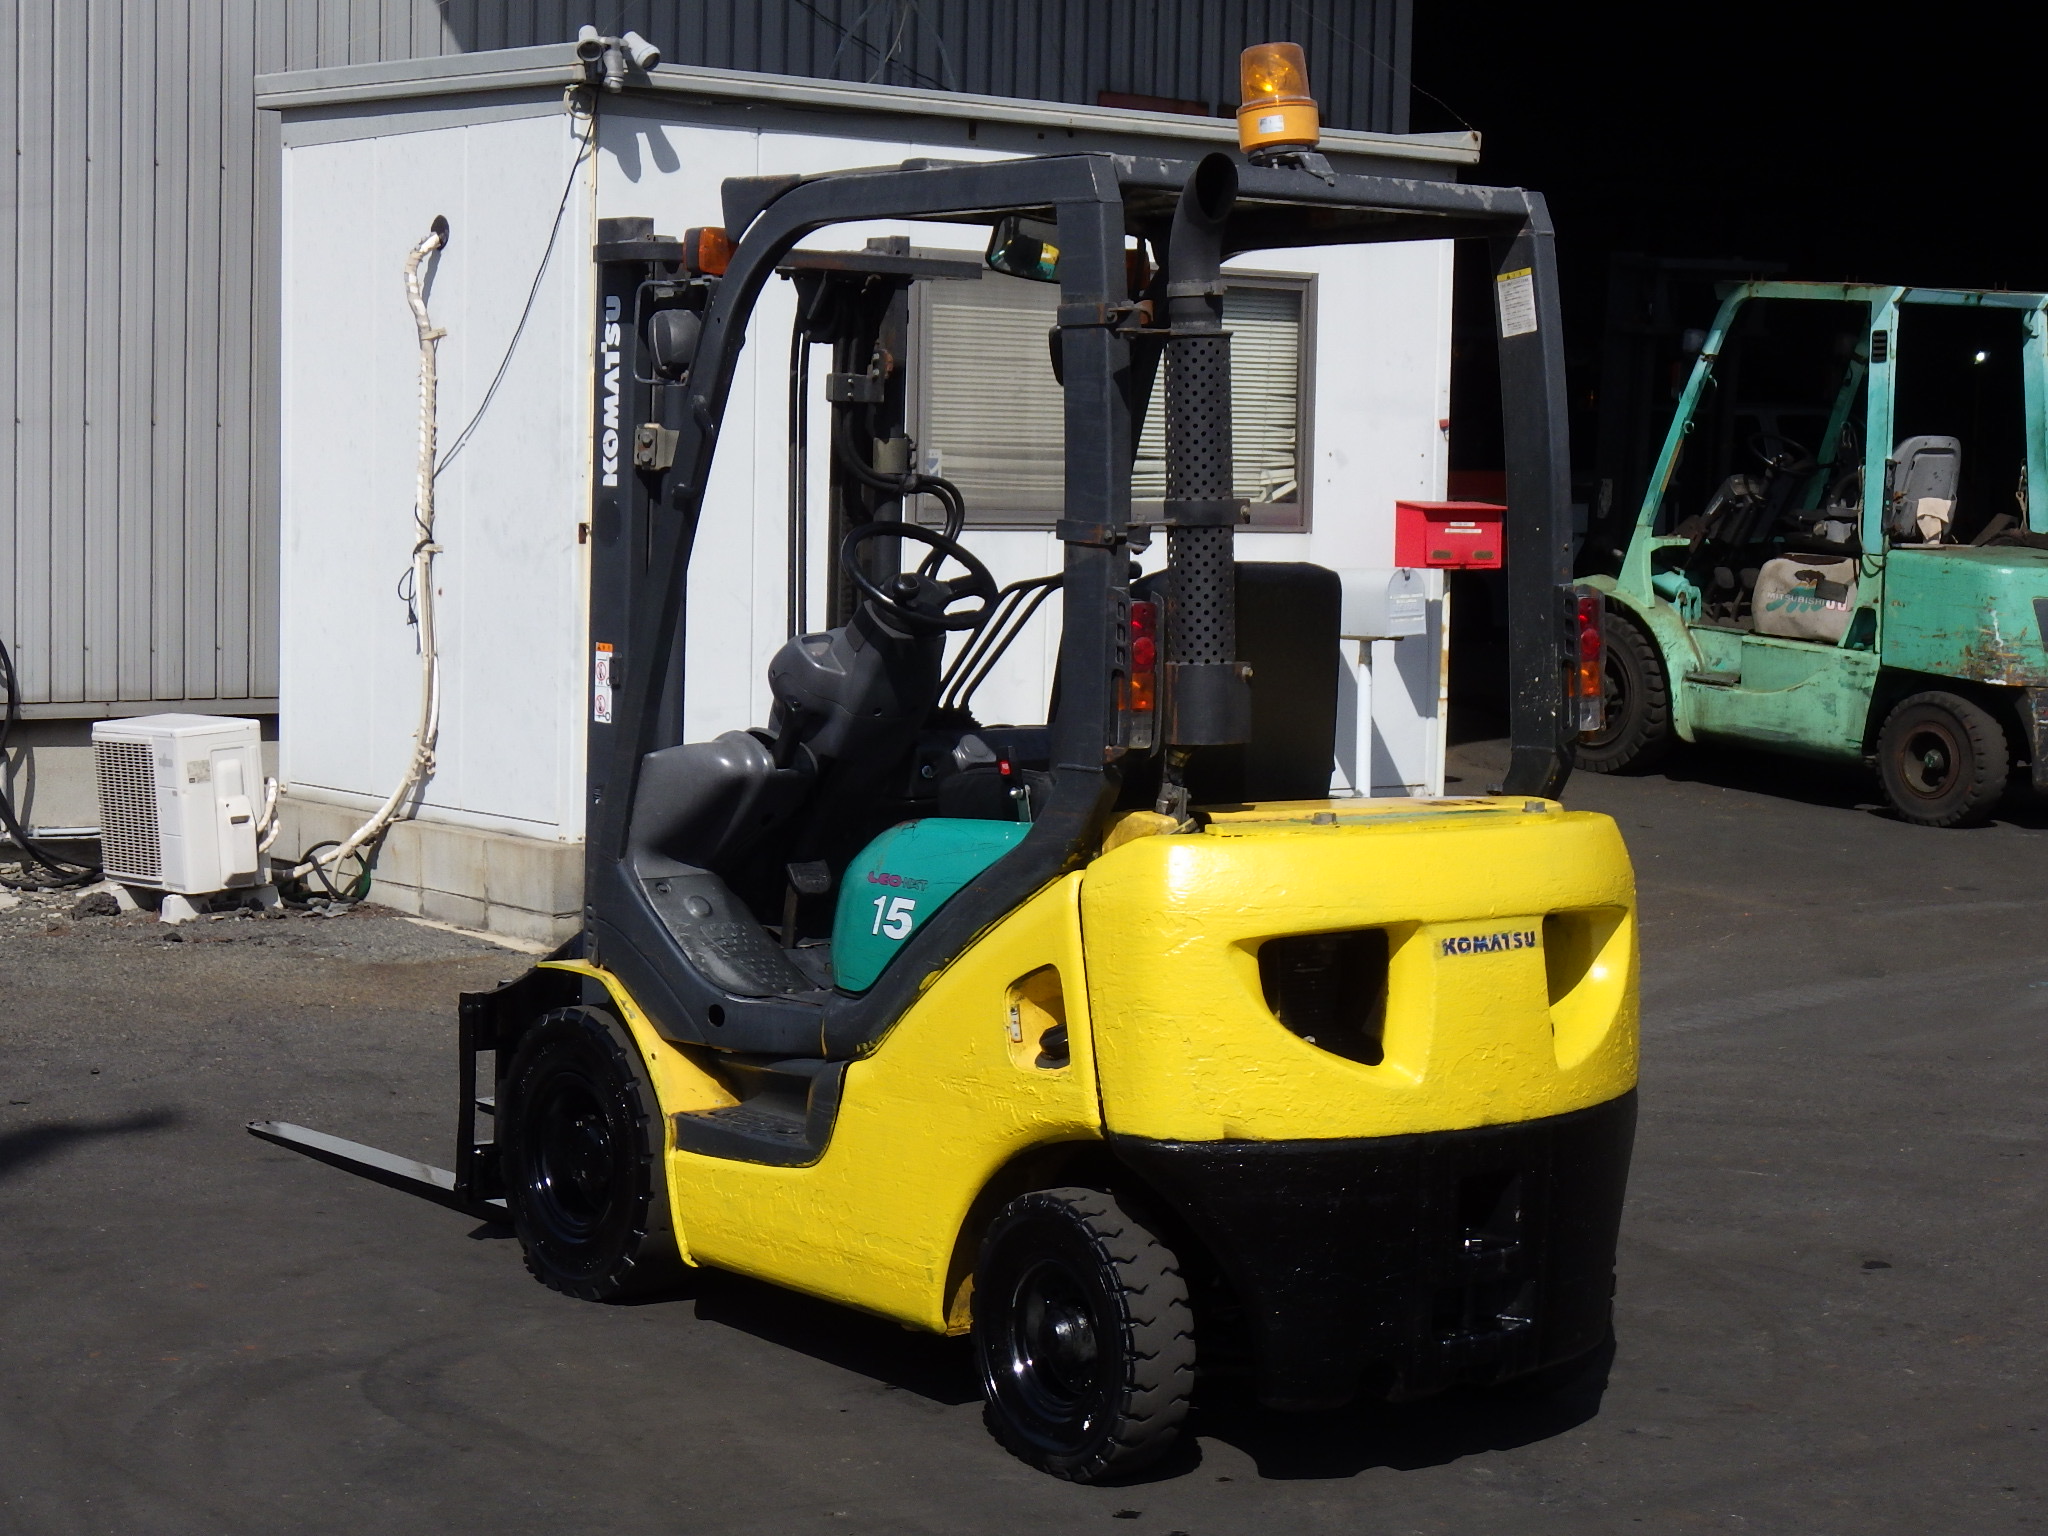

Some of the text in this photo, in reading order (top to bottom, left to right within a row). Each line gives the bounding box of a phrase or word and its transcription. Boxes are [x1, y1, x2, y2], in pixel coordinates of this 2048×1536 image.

[602, 295, 621, 486] KOMATSU
[1766, 592, 1826, 606] MITSUBISHI
[872, 895, 916, 940] 15
[1442, 931, 1535, 956] KOMATSU
